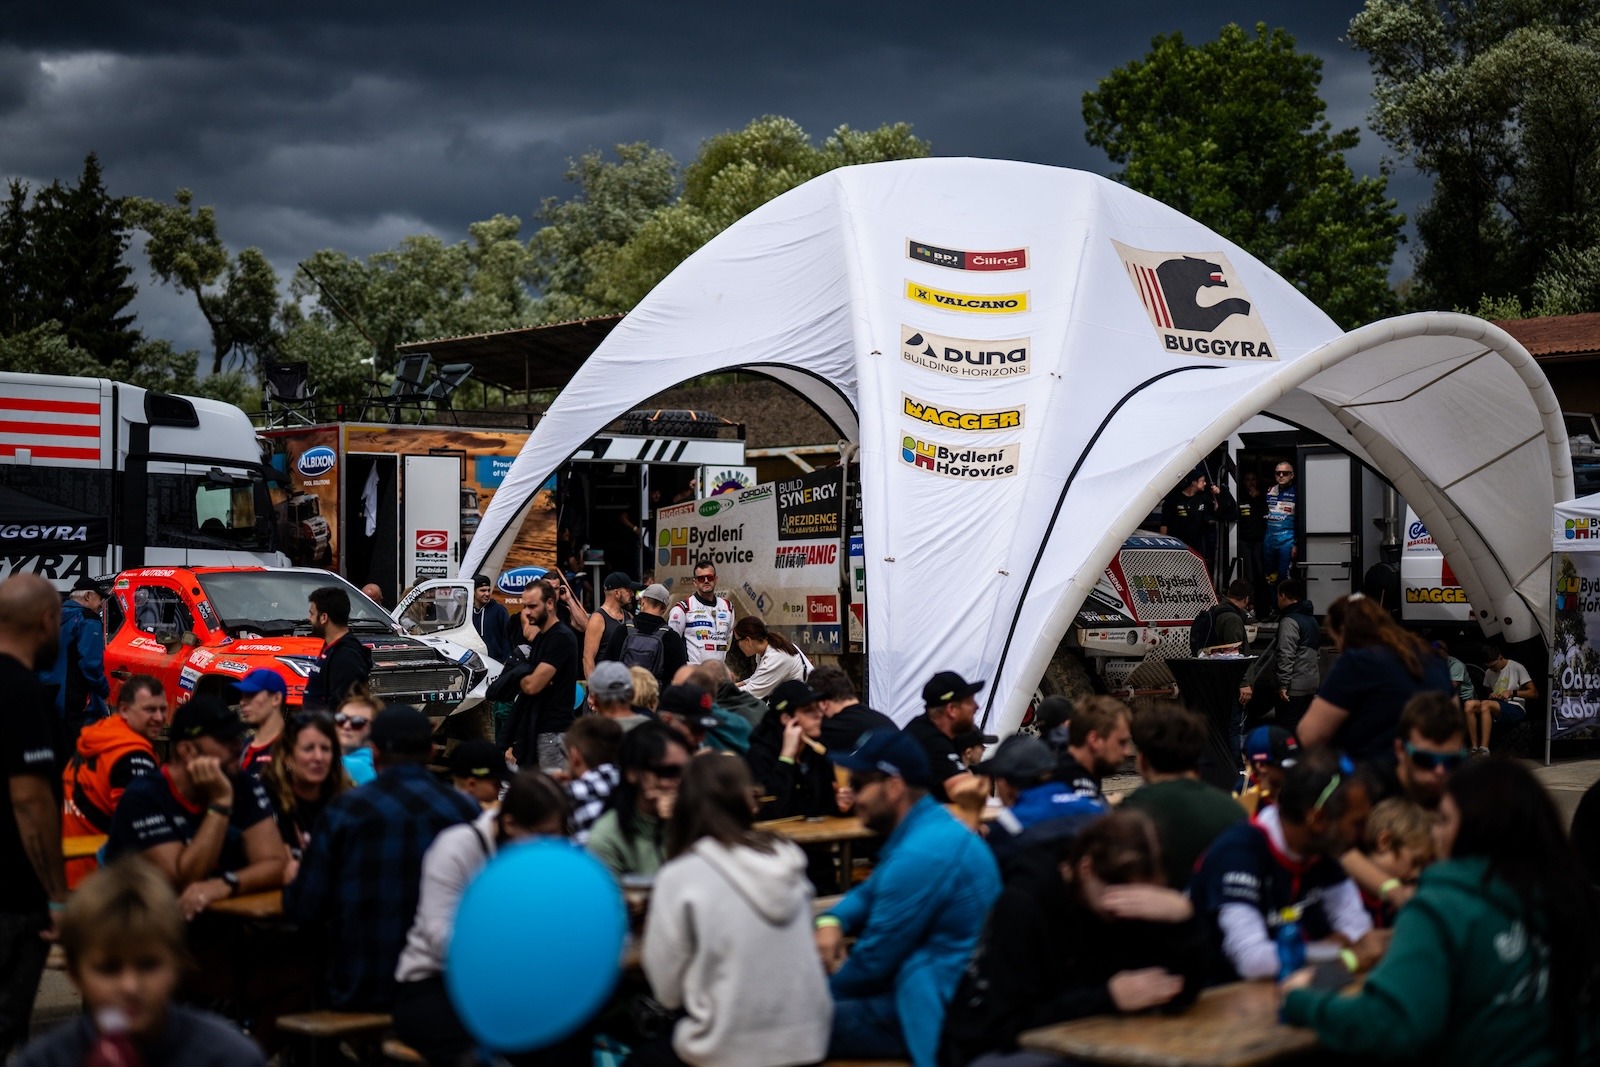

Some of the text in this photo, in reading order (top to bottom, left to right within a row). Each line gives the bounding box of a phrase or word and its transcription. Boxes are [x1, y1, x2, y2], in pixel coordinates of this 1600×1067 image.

[933, 252, 958, 262] BPJ
[972, 255, 1018, 265] Čilina
[933, 294, 1018, 309] VALCANO
[1164, 334, 1273, 358] BUGGYRA
[903, 351, 1026, 377] BUILDING HORIZONS
[300, 453, 334, 469] ALBIXON
[937, 446, 1005, 464] Bydlení
[936, 461, 1014, 478] Hořovice
[739, 485, 772, 501] JORDÁK
[779, 478, 803, 494] BUILD
[780, 482, 837, 509] SYNERGY
[661, 505, 694, 520] BIGGEST
[789, 512, 838, 526] REZIDENCE
[689, 523, 745, 548] Bydlení
[689, 546, 754, 566] Hořovice
[140, 569, 176, 577] NUTREND
[417, 566, 447, 574] Fabián
[500, 573, 541, 588] ALBIXO
[1580, 576, 1600, 597] Byd
[742, 582, 758, 601] KSB
[1406, 587, 1469, 604] BAGGE
[791, 605, 804, 613] BPJ
[810, 601, 834, 613] Čilina
[1579, 596, 1600, 613] Hoř
[235, 643, 283, 652] NUTREND
[1561, 666, 1582, 689] Od
[421, 691, 463, 701] LERAM
[1561, 696, 1600, 718] dobr
